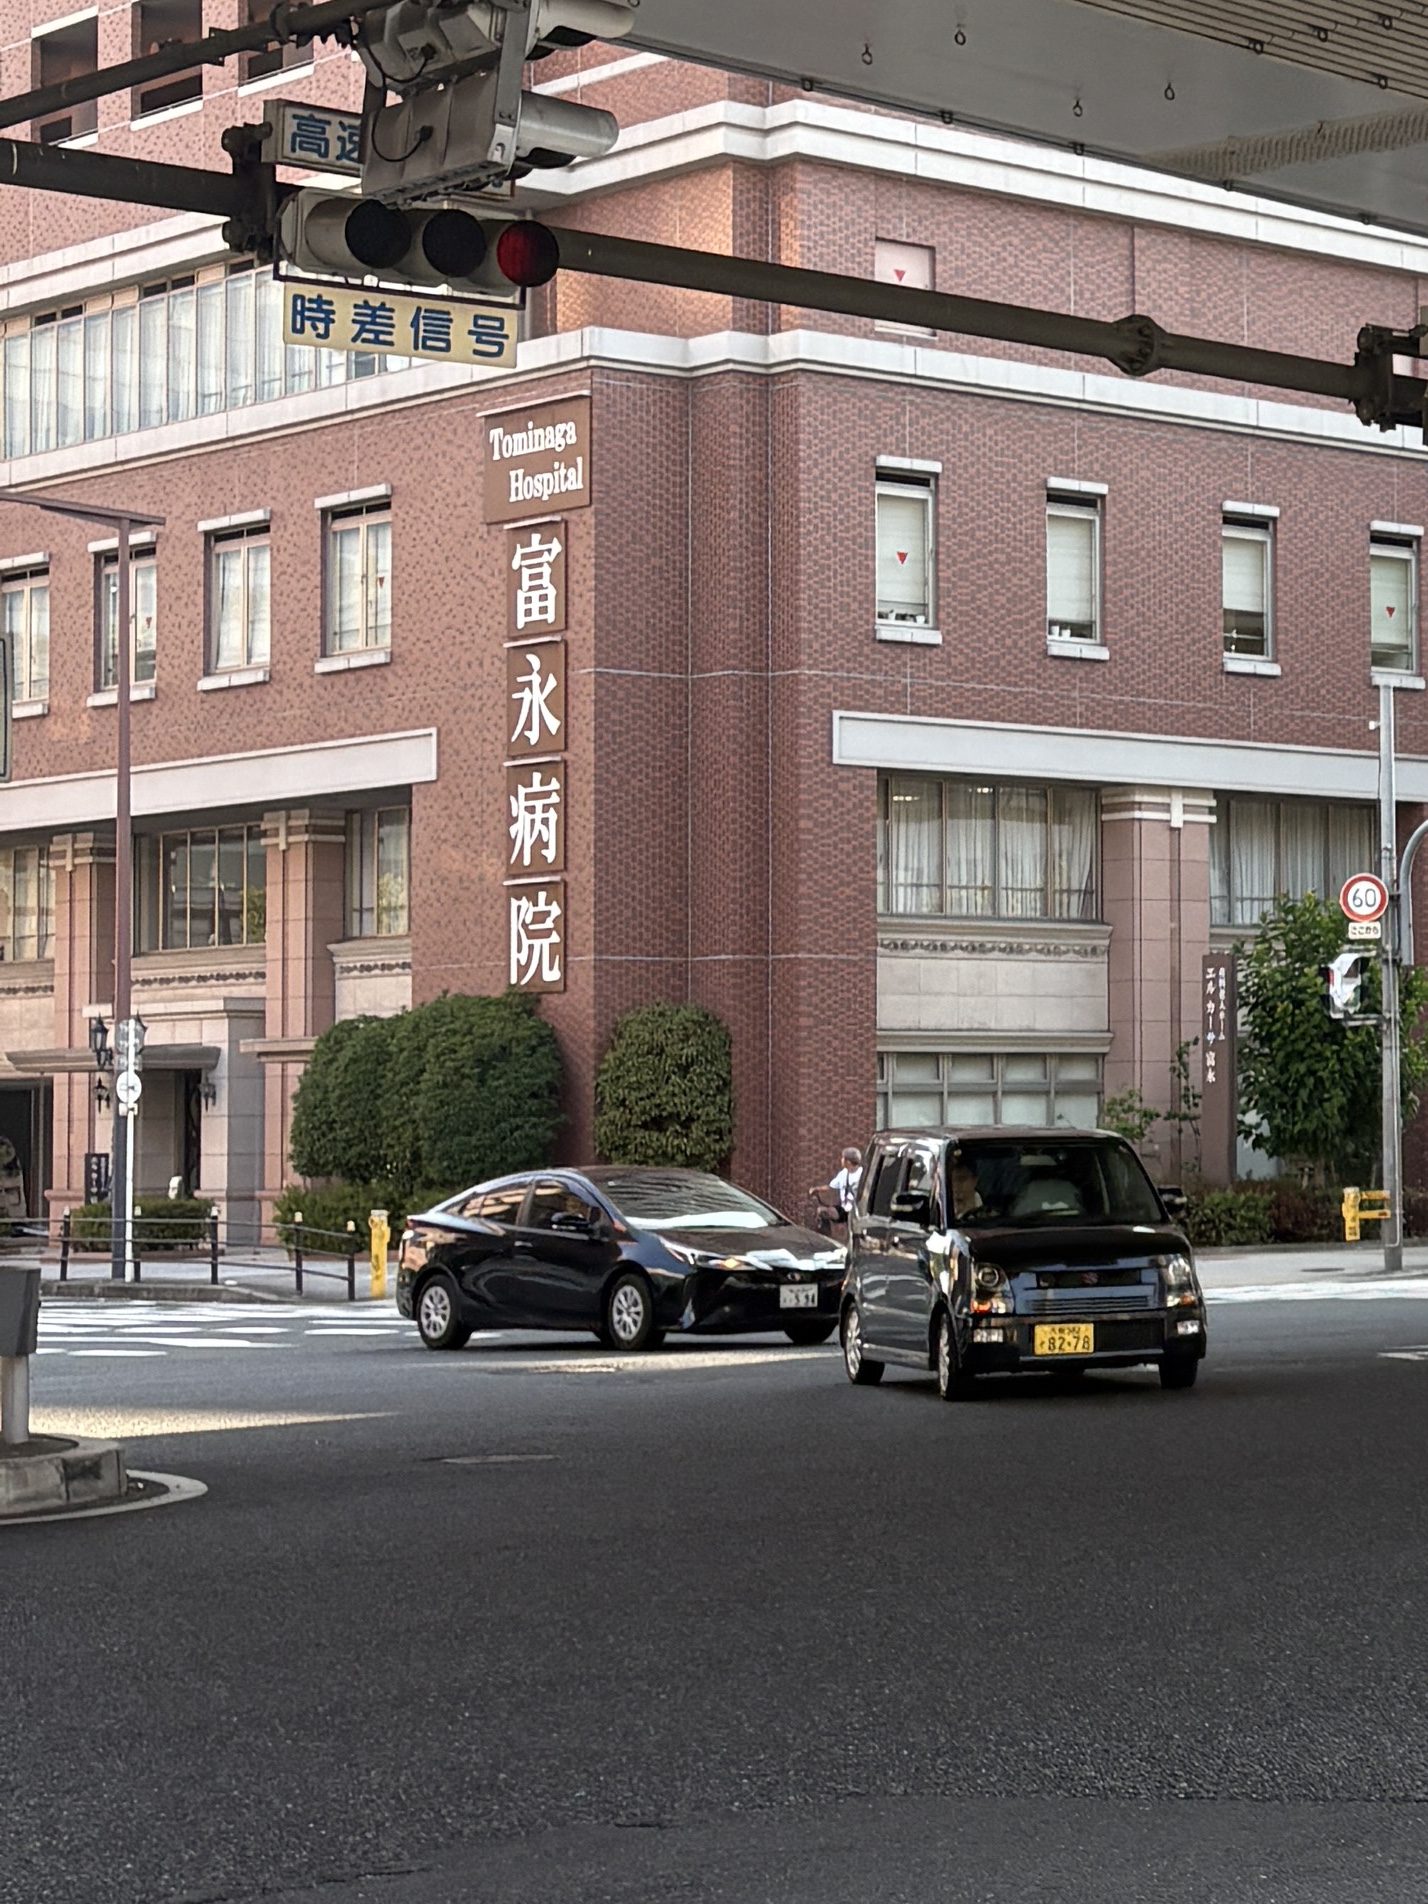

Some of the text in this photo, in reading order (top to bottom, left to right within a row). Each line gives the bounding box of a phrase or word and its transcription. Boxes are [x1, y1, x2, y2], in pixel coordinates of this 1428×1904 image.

[291, 293, 509, 358] 時差信号
[489, 416, 577, 460] Tominaga
[508, 457, 584, 502] Hospital
[509, 532, 562, 986] 富永病院
[1352, 888, 1377, 908] 60
